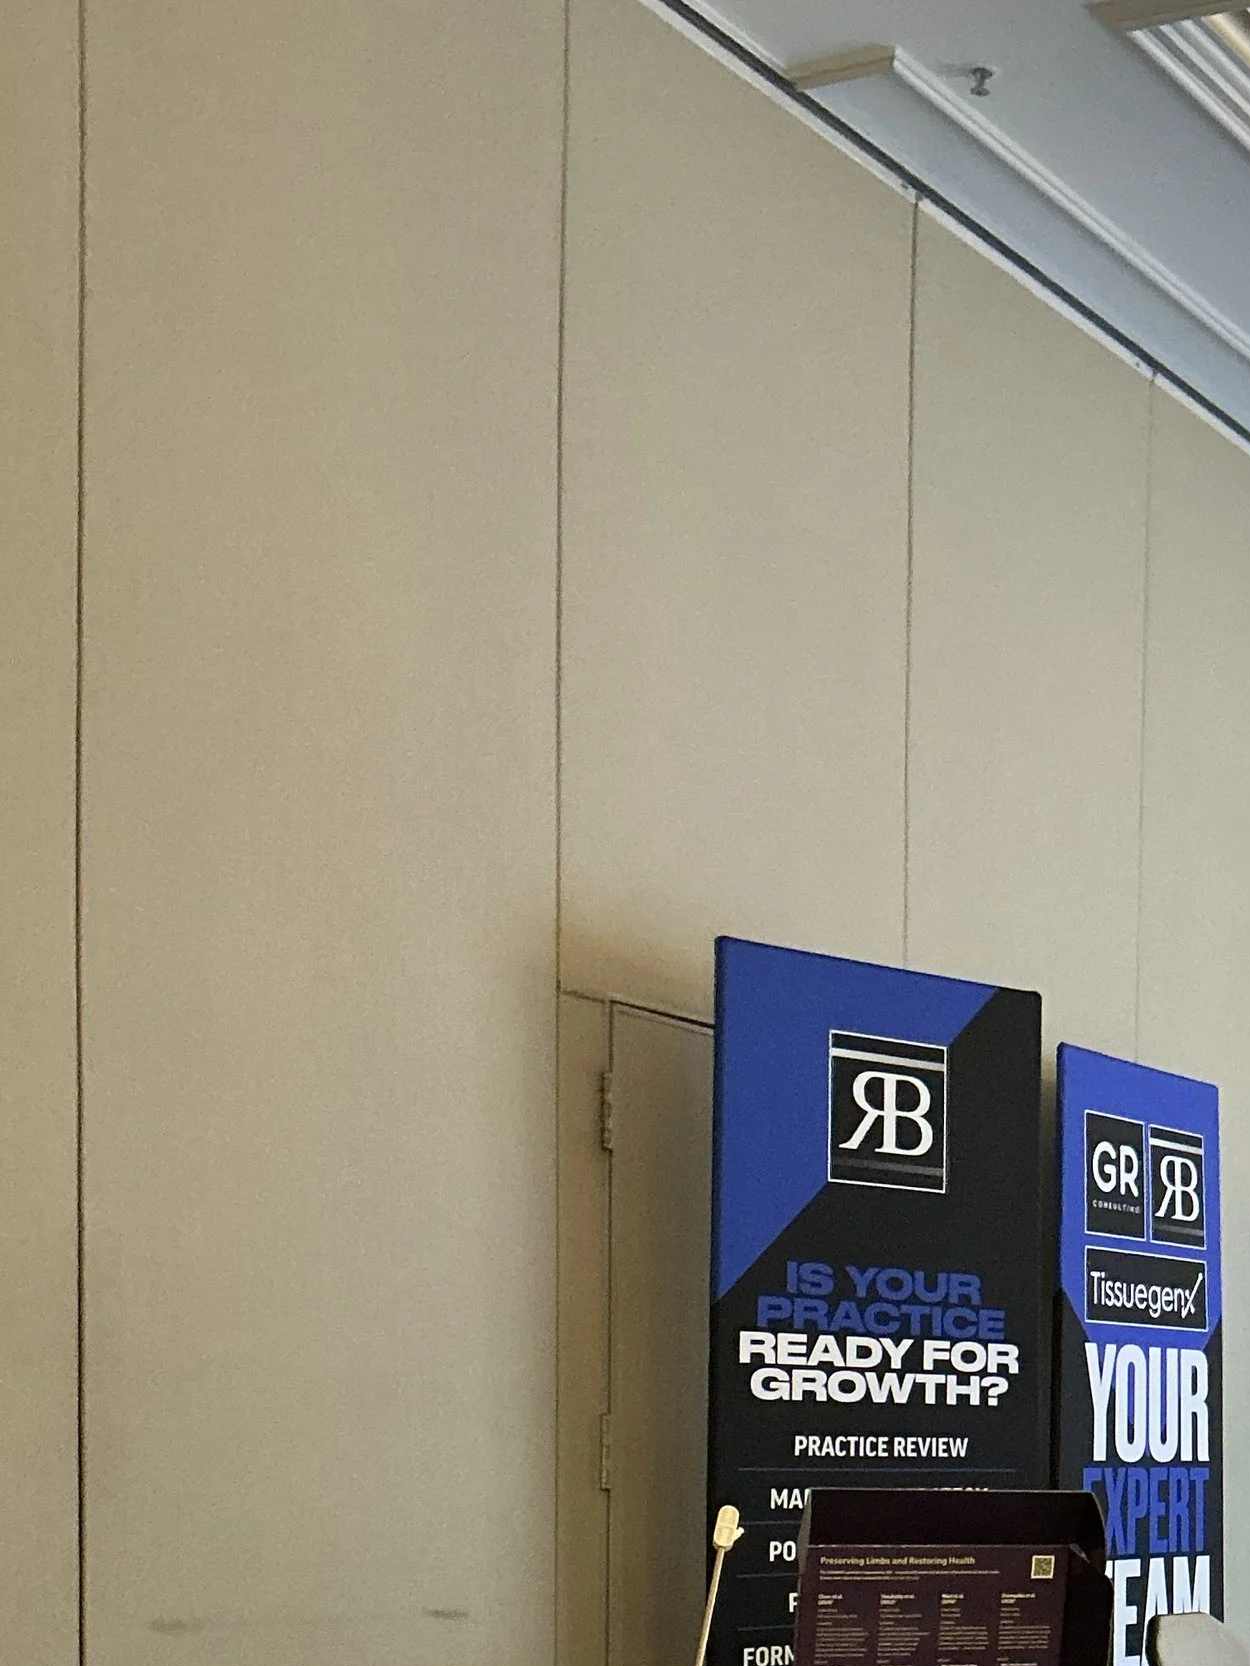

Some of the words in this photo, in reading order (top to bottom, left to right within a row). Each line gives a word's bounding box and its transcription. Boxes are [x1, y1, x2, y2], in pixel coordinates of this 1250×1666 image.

[1092, 1141, 1138, 1197] GR
[787, 1260, 834, 1296] IS
[846, 1265, 982, 1305] YOUR
[757, 1295, 1005, 1340] PRACTICE
[739, 1331, 914, 1369] READY
[923, 1339, 1019, 1374] FOR
[750, 1367, 1009, 1406] GROWTH?
[1085, 1342, 1210, 1463] YOUR
[794, 1435, 889, 1457] PRACTICE
[894, 1437, 969, 1458] REVIEW
[820, 1557, 864, 1567] Preserving
[866, 1557, 890, 1566] Limbs
[892, 1557, 907, 1566] and
[909, 1557, 947, 1567] Restoring
[949, 1557, 975, 1565] Health
